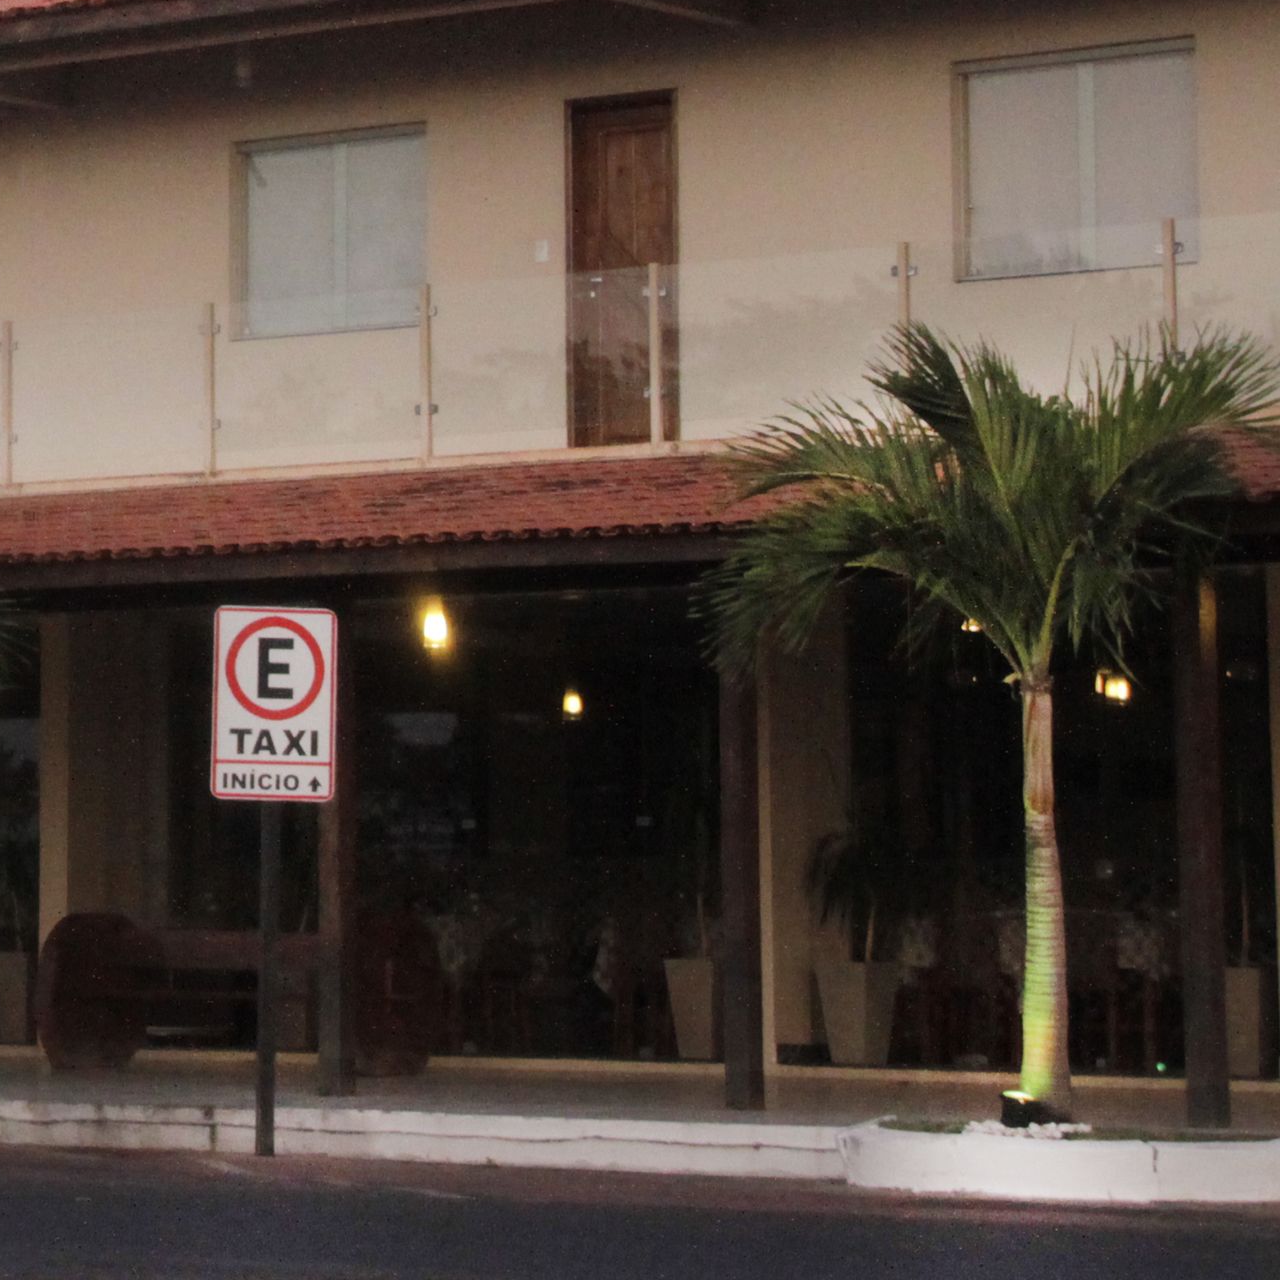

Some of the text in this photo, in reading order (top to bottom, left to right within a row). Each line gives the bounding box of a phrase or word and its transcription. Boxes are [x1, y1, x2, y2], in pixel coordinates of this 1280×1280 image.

[257, 637, 294, 699] E
[229, 728, 318, 757] TAXI
[222, 769, 300, 792] INÍCIO
